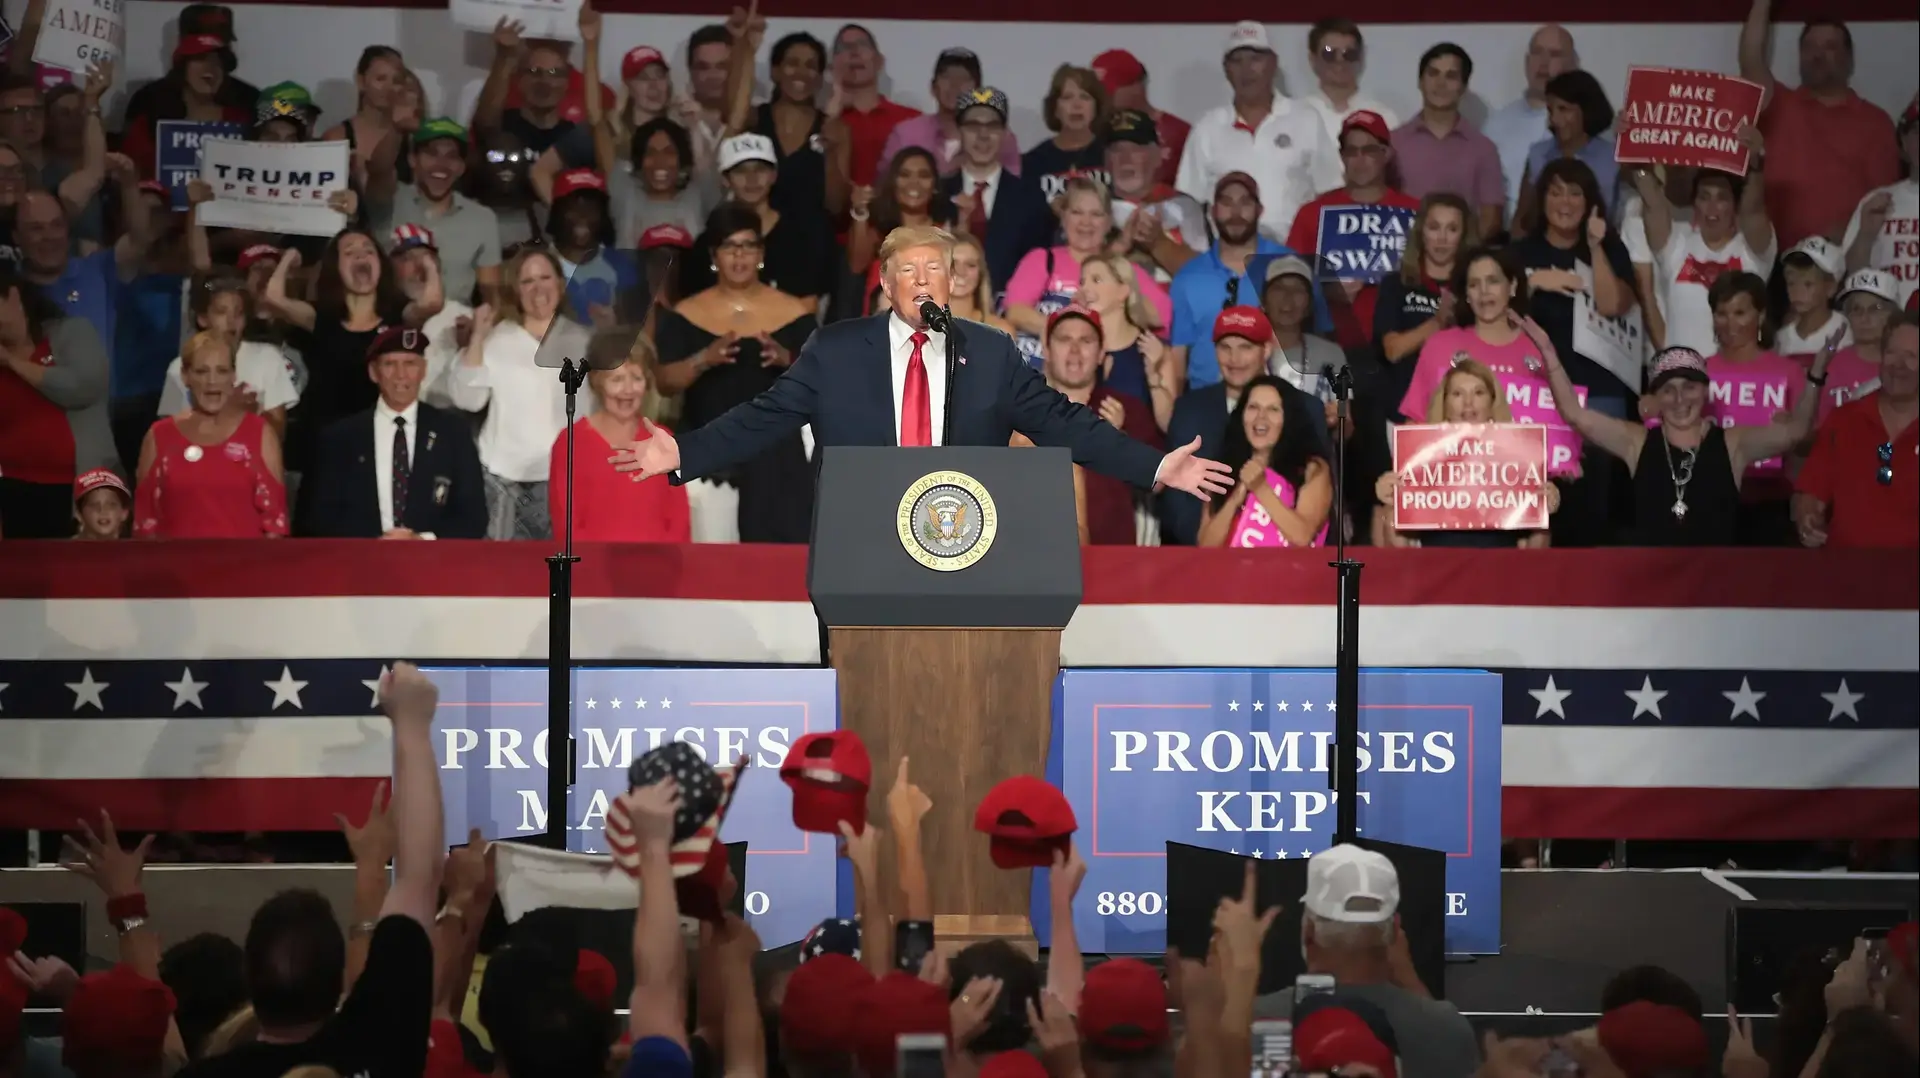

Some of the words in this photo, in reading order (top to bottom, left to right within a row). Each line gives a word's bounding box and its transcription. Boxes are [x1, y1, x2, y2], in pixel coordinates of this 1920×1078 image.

[1669, 83, 1716, 101] MAKE
[1629, 128, 1681, 146] GREAT
[1682, 131, 1739, 154] AGAIN
[214, 164, 335, 186] TRUMP
[224, 183, 324, 199] PENCE
[1337, 212, 1416, 235] DRA
[1368, 234, 1407, 251] THE
[1893, 241, 1919, 258] FO
[1325, 249, 1403, 272] SWA
[1851, 274, 1879, 288] USA
[1708, 380, 1786, 408] MEN
[1446, 440, 1495, 456] MAKE
[1401, 461, 1542, 487] AMERICA
[900, 474, 945, 519] PRESIDENT
[972, 486, 994, 527] UNITED
[1402, 490, 1472, 510] PROUD
[1476, 490, 1539, 509] AGAIN
[516, 789, 612, 831] MA
[1096, 891, 1167, 916] 880
